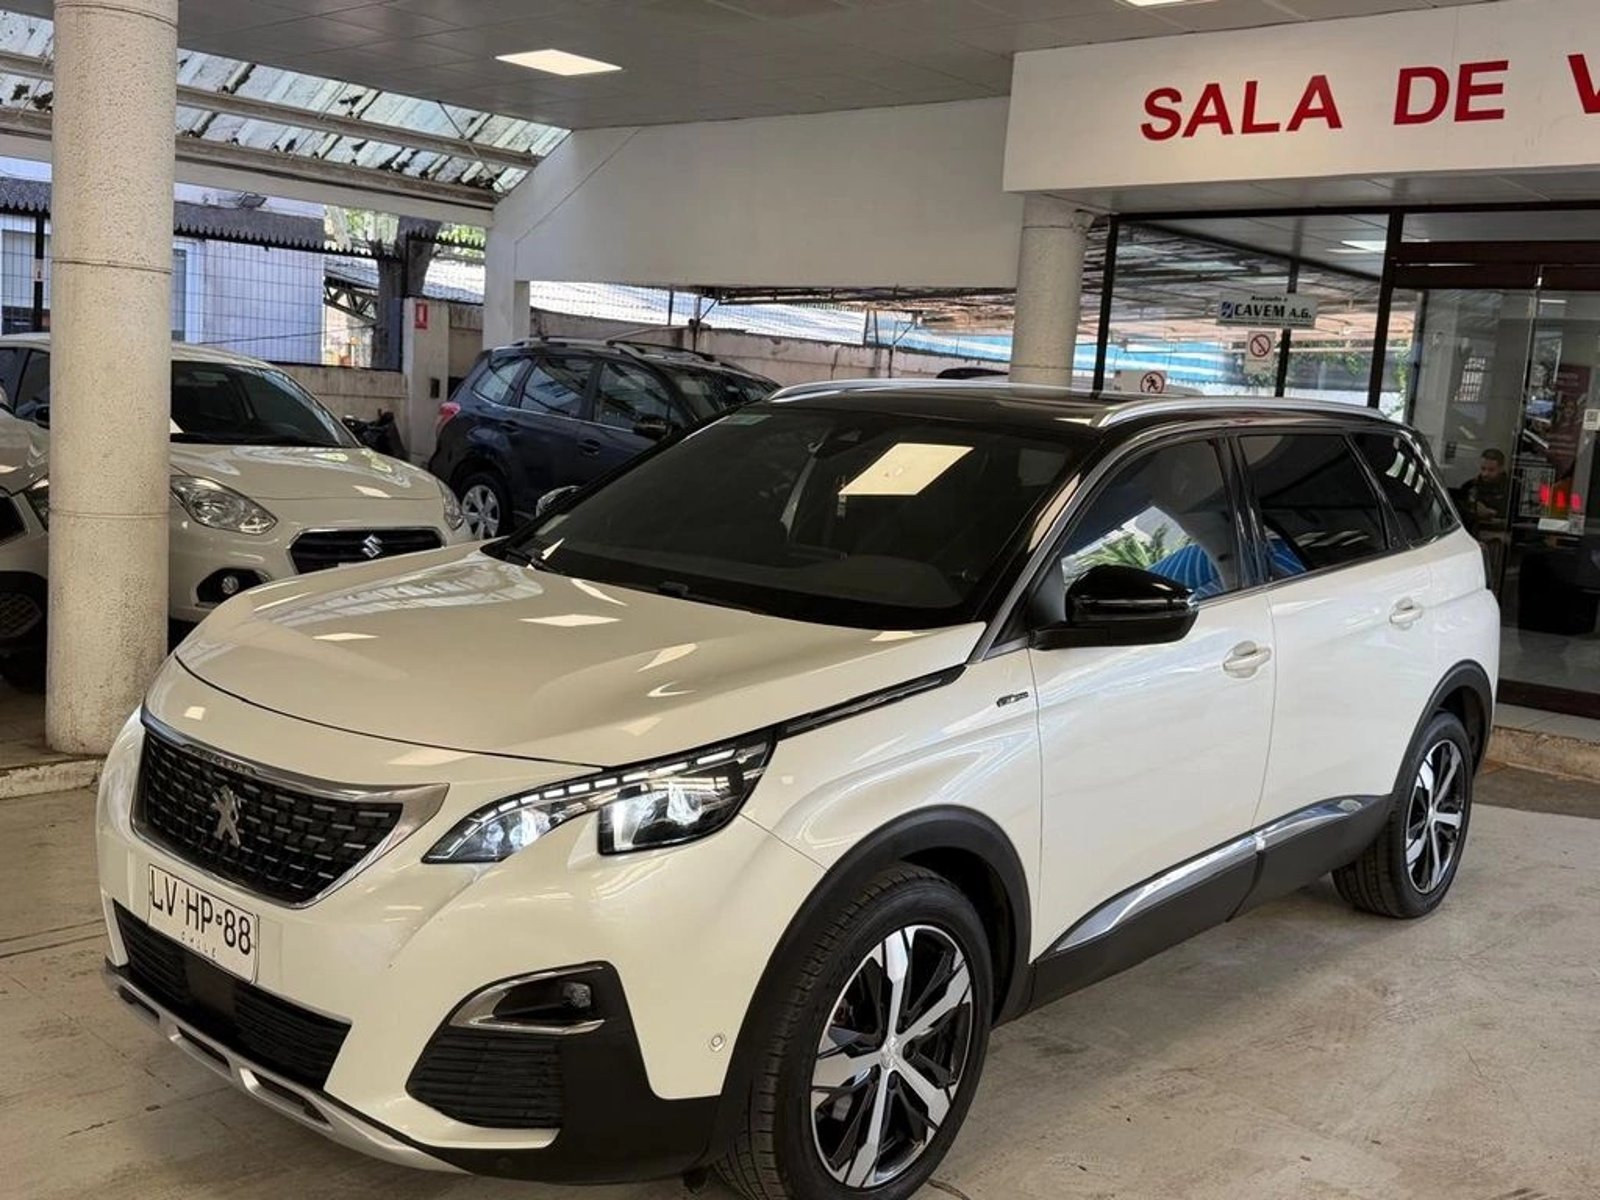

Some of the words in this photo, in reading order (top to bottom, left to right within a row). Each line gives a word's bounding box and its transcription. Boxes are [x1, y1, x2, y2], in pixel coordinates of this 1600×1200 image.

[1140, 75, 1343, 141] SALA
[1393, 61, 1509, 125] DE
[1234, 303, 1285, 318] CAVEM
